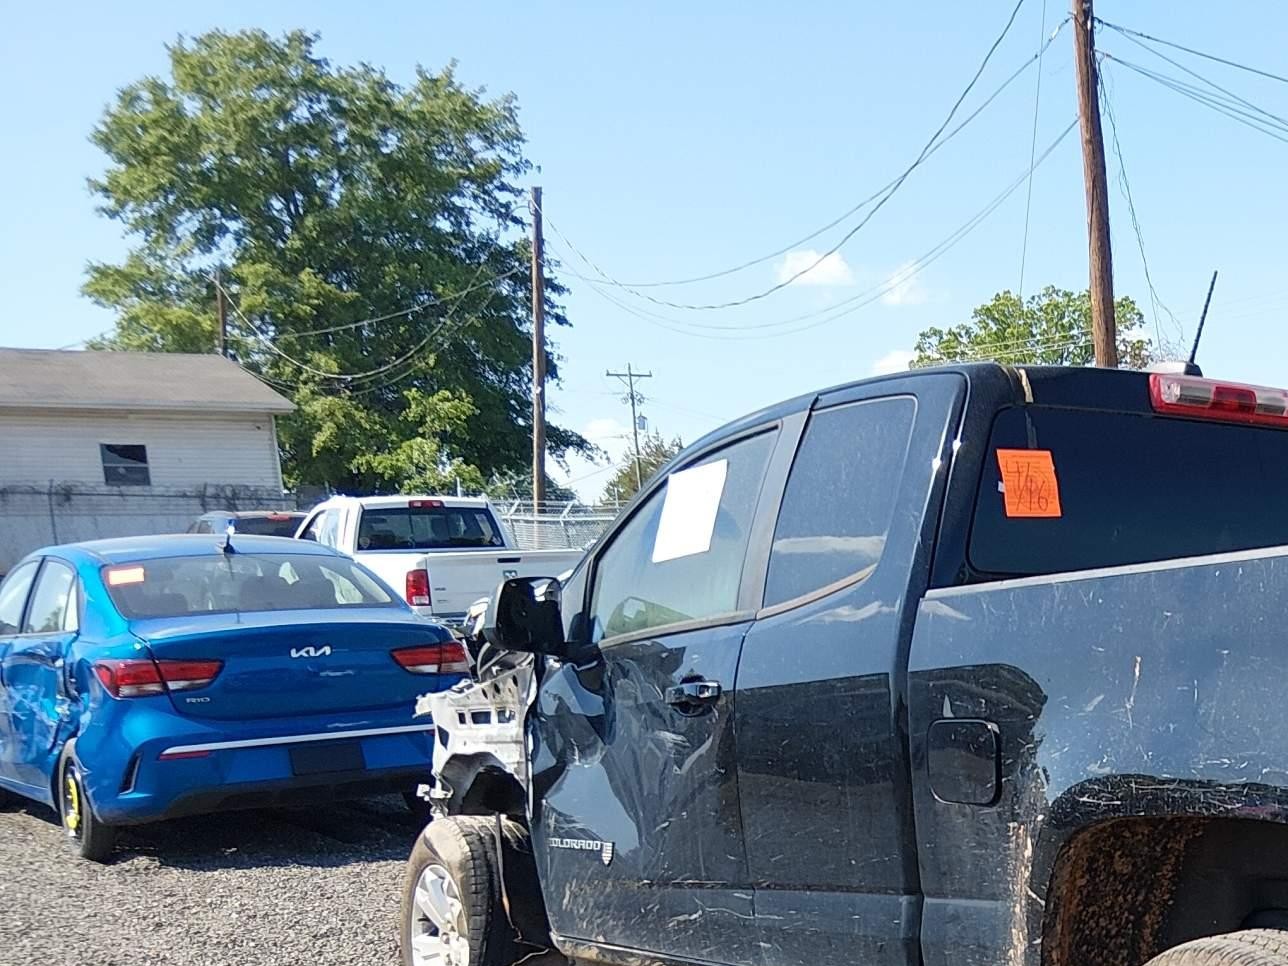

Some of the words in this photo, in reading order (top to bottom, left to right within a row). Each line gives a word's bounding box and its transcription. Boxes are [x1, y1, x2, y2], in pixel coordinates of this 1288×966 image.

[290, 645, 332, 658] KIA
[185, 696, 211, 704] RIO
[545, 837, 601, 851] COLORADO
